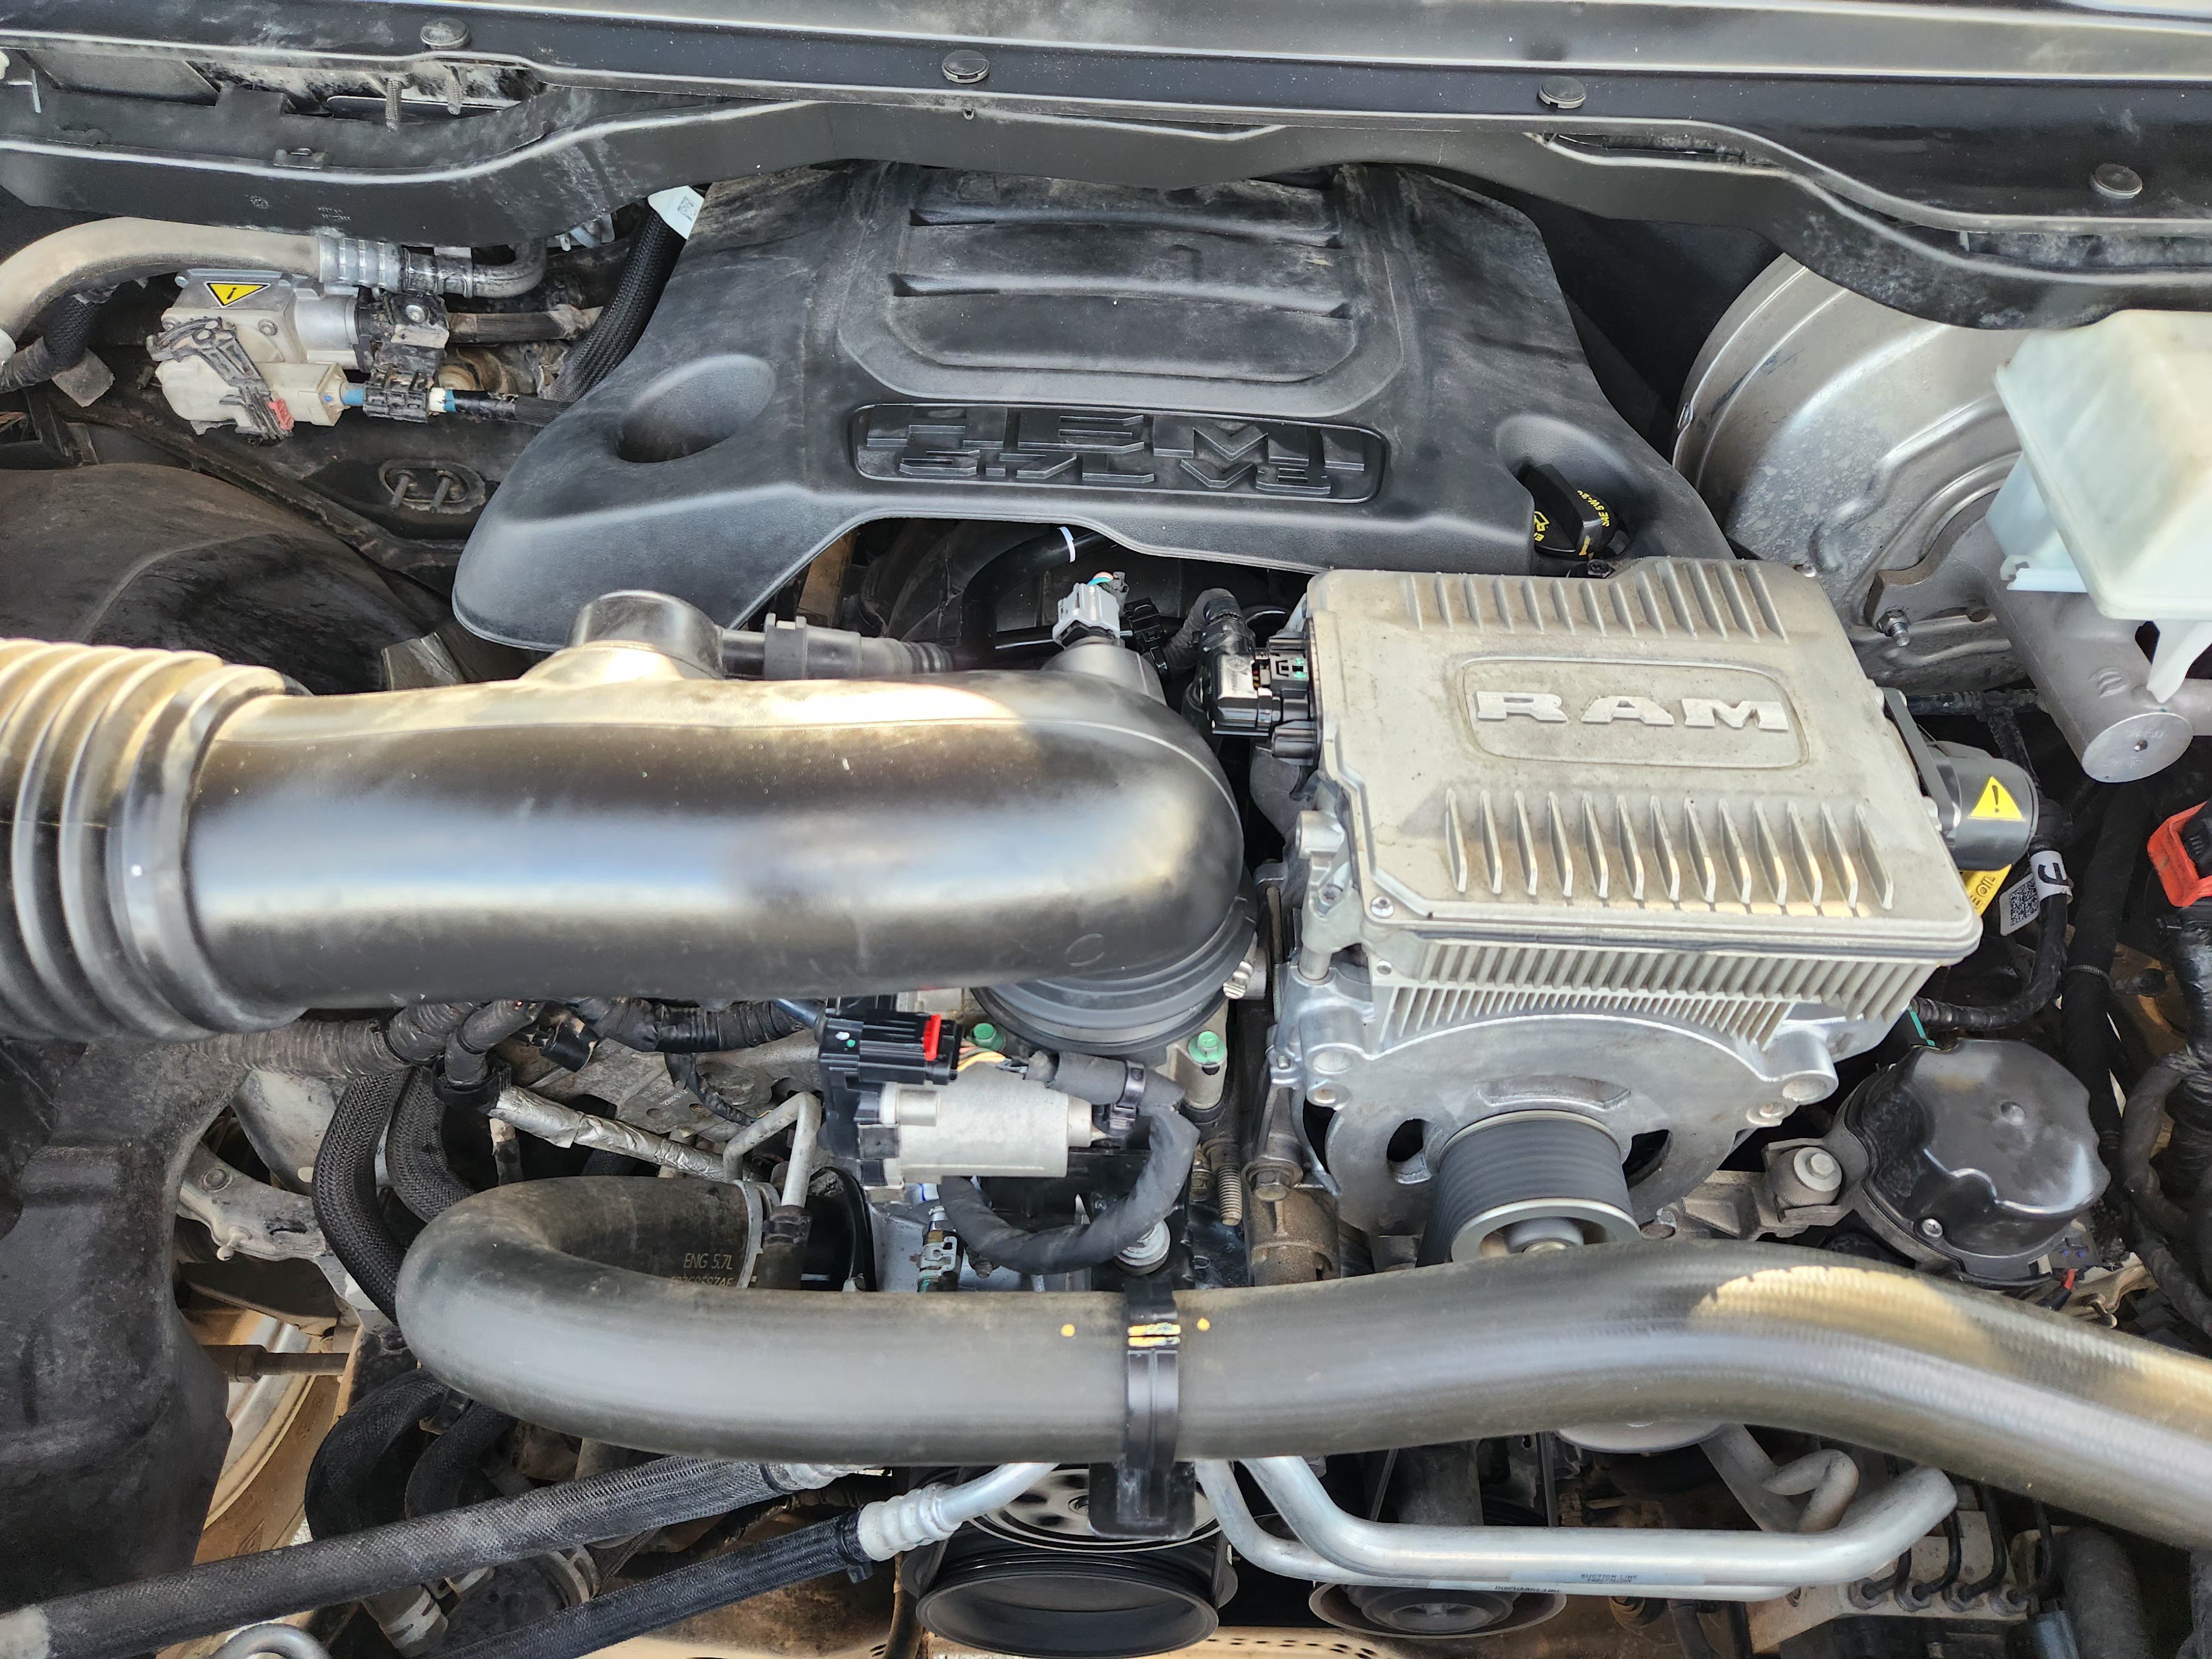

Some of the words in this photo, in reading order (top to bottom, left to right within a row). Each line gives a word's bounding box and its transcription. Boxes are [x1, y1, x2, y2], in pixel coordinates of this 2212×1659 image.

[867, 406, 1365, 471] HEMI
[899, 449, 1155, 484] 5.7L
[1598, 512, 1610, 527] SAE
[1476, 690, 1790, 731] RAM
[1976, 876, 1995, 898] OIL
[684, 1253, 709, 1269] ENG
[711, 1253, 733, 1270] 5.7L
